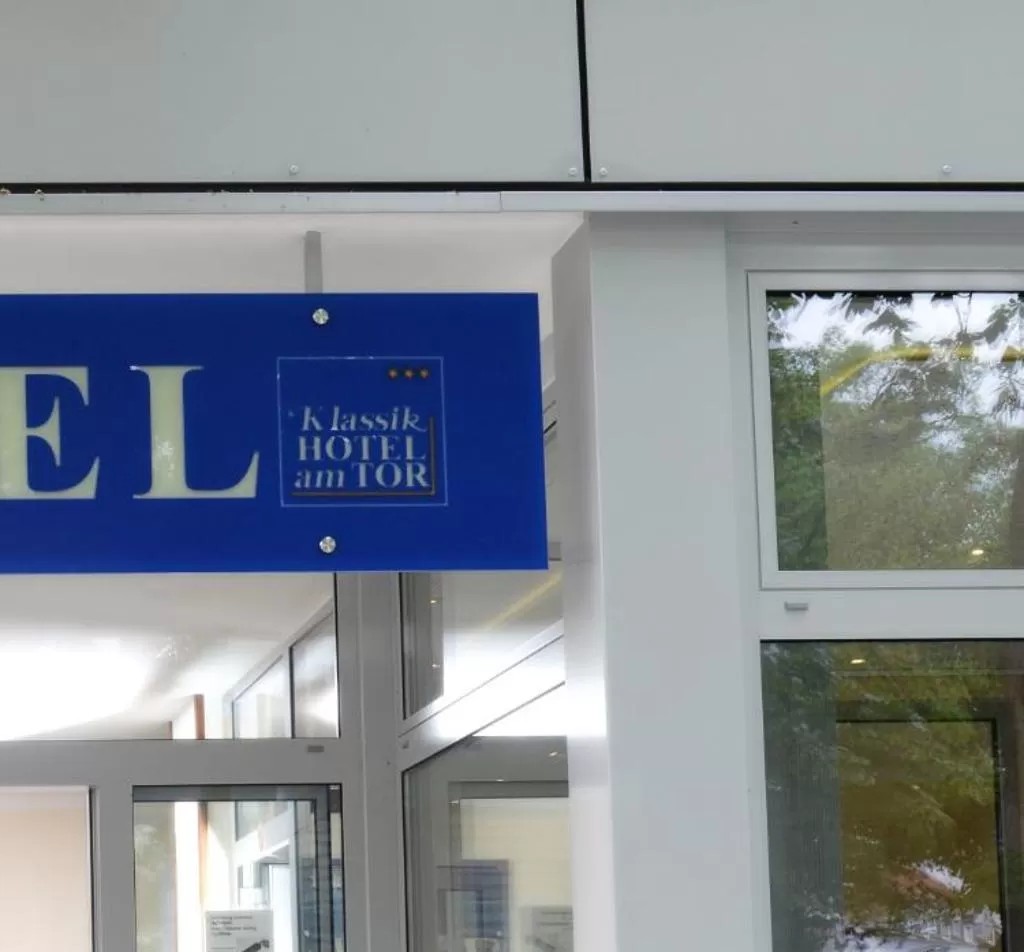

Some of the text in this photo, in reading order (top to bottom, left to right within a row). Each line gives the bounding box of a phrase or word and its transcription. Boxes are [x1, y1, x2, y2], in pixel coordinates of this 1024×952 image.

[288, 405, 427, 432] Klassik
[298, 434, 426, 461] HOTEL
[294, 461, 430, 489] am TOR
